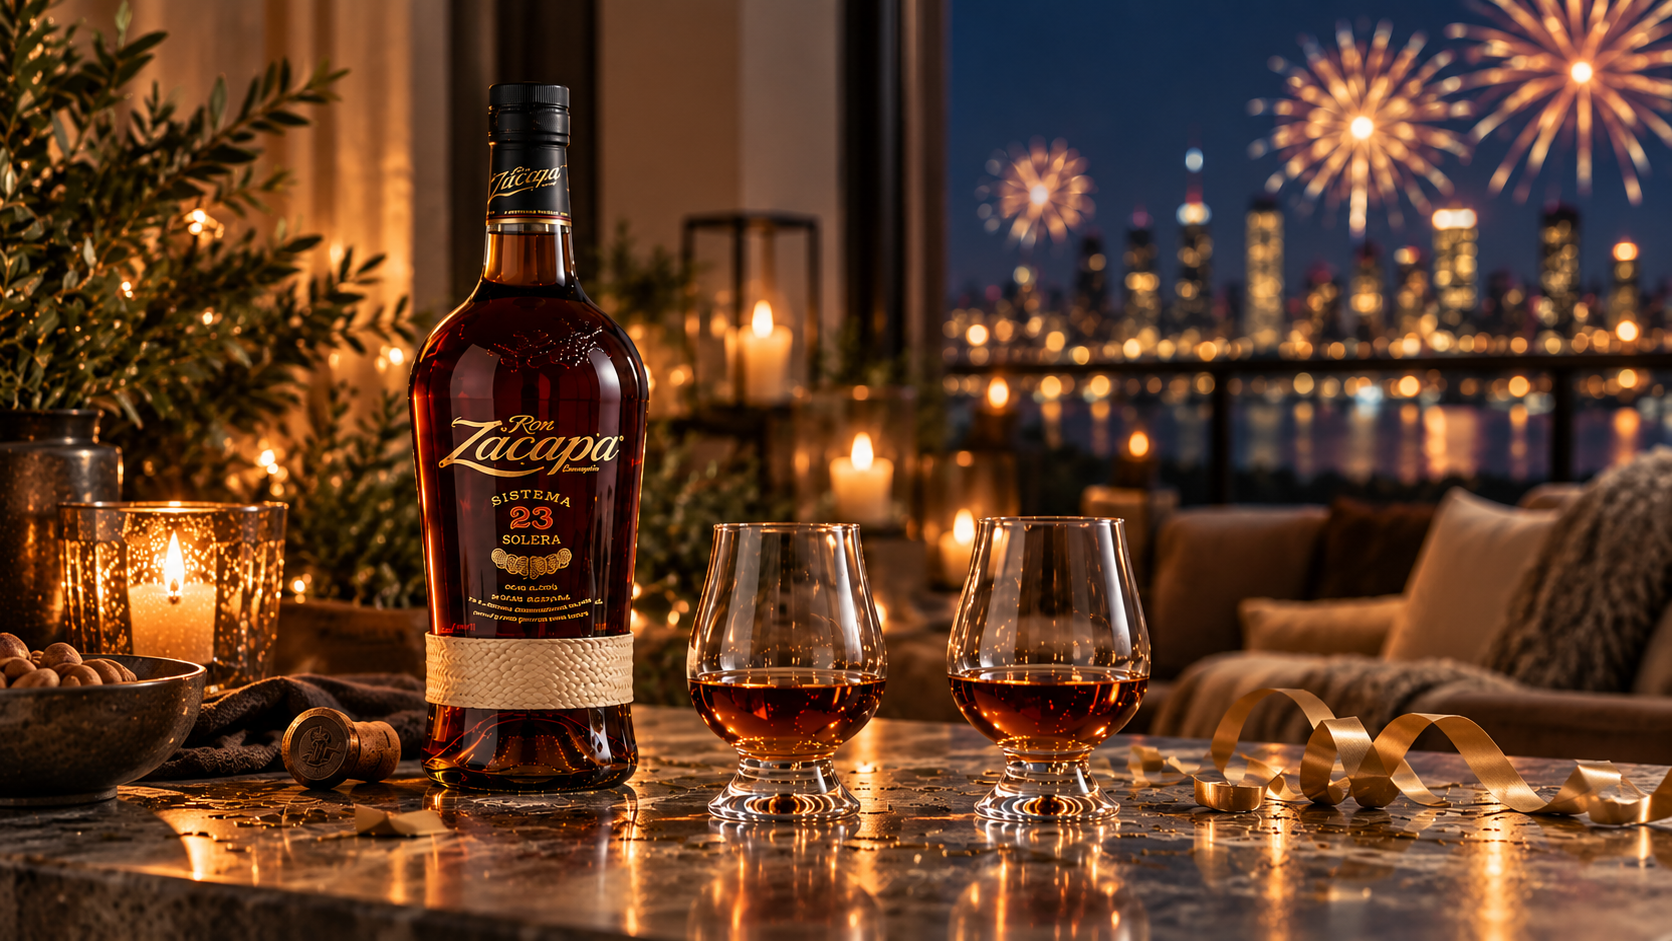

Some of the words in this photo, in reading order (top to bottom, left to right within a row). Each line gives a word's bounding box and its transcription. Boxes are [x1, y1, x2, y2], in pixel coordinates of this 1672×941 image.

[508, 414, 555, 435] Ron
[438, 416, 620, 478] Zacapa
[491, 489, 571, 508] SISTEMA
[509, 505, 554, 530] 23
[502, 534, 561, 545] SOLERA
